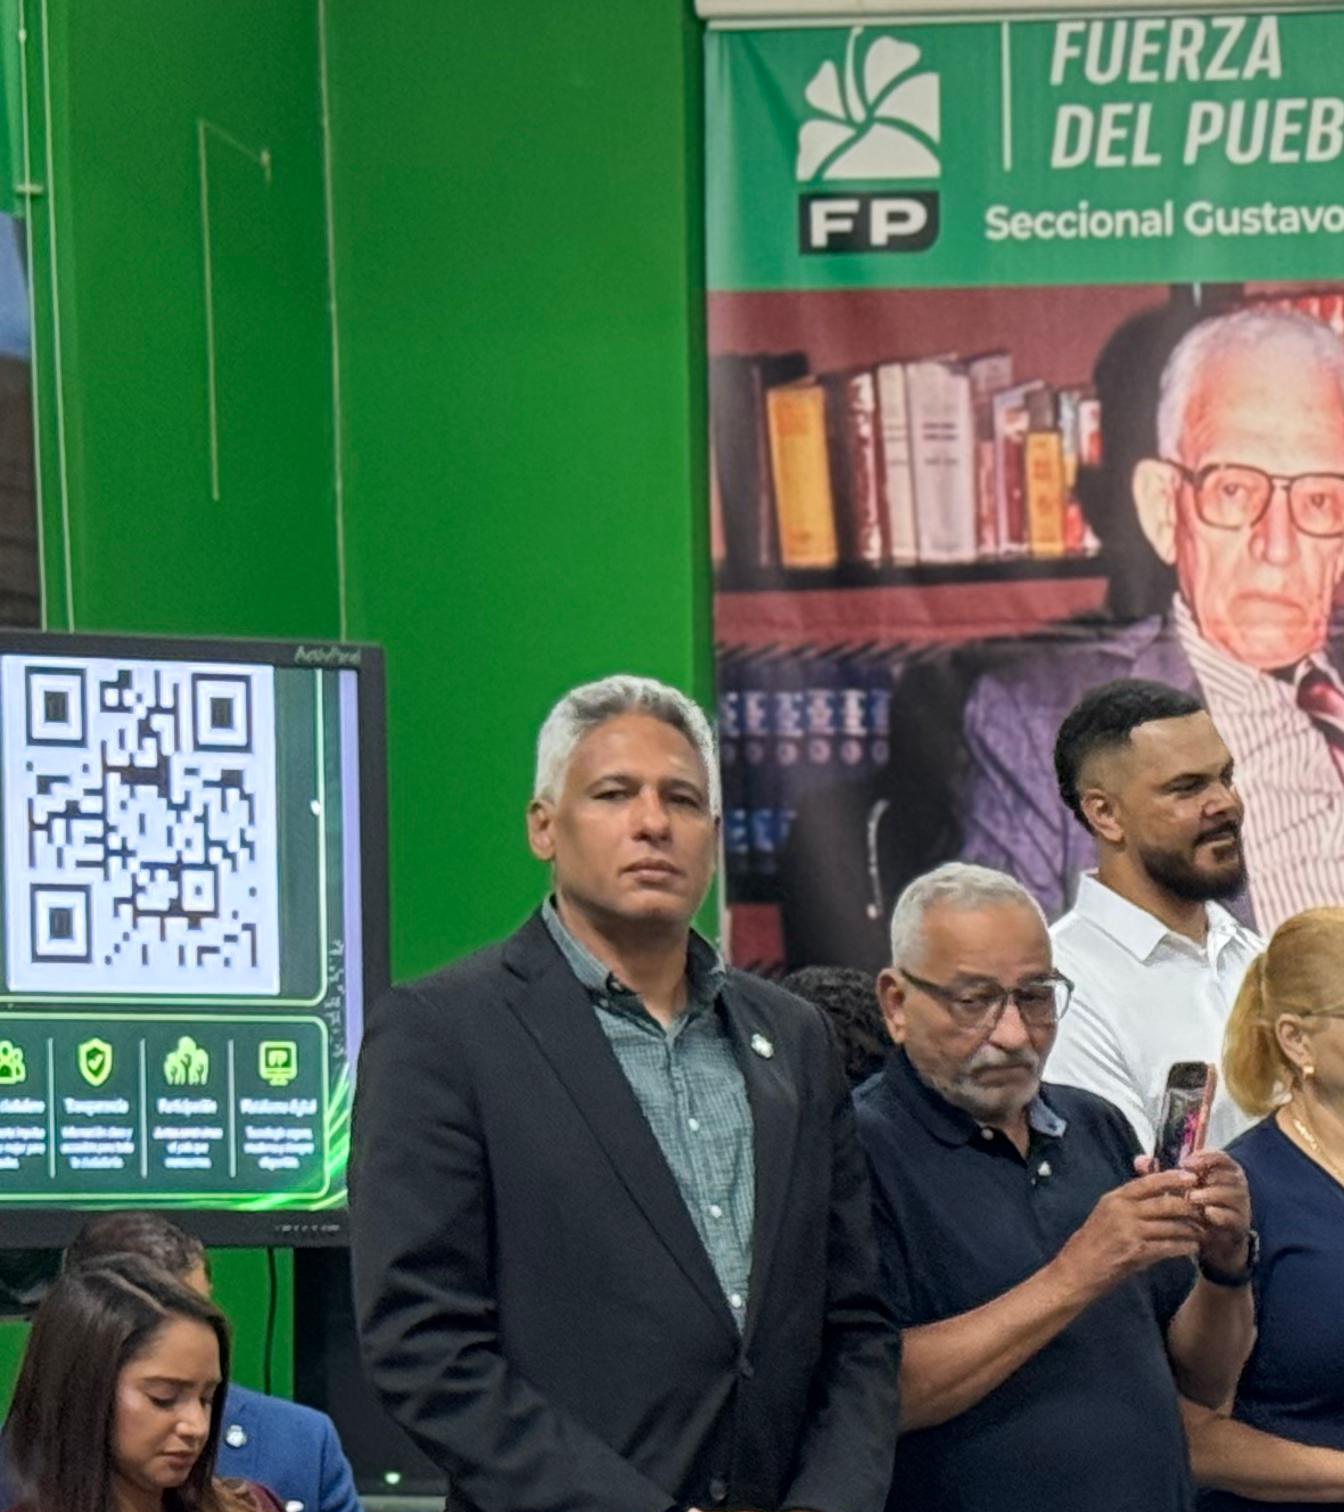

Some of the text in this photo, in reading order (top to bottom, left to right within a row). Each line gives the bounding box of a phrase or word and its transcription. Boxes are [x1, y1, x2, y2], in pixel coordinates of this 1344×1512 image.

[1050, 15, 1282, 86] FUERZA
[1051, 102, 1161, 169] DEL
[810, 198, 928, 248] FP
[985, 200, 1173, 241] Seccional
